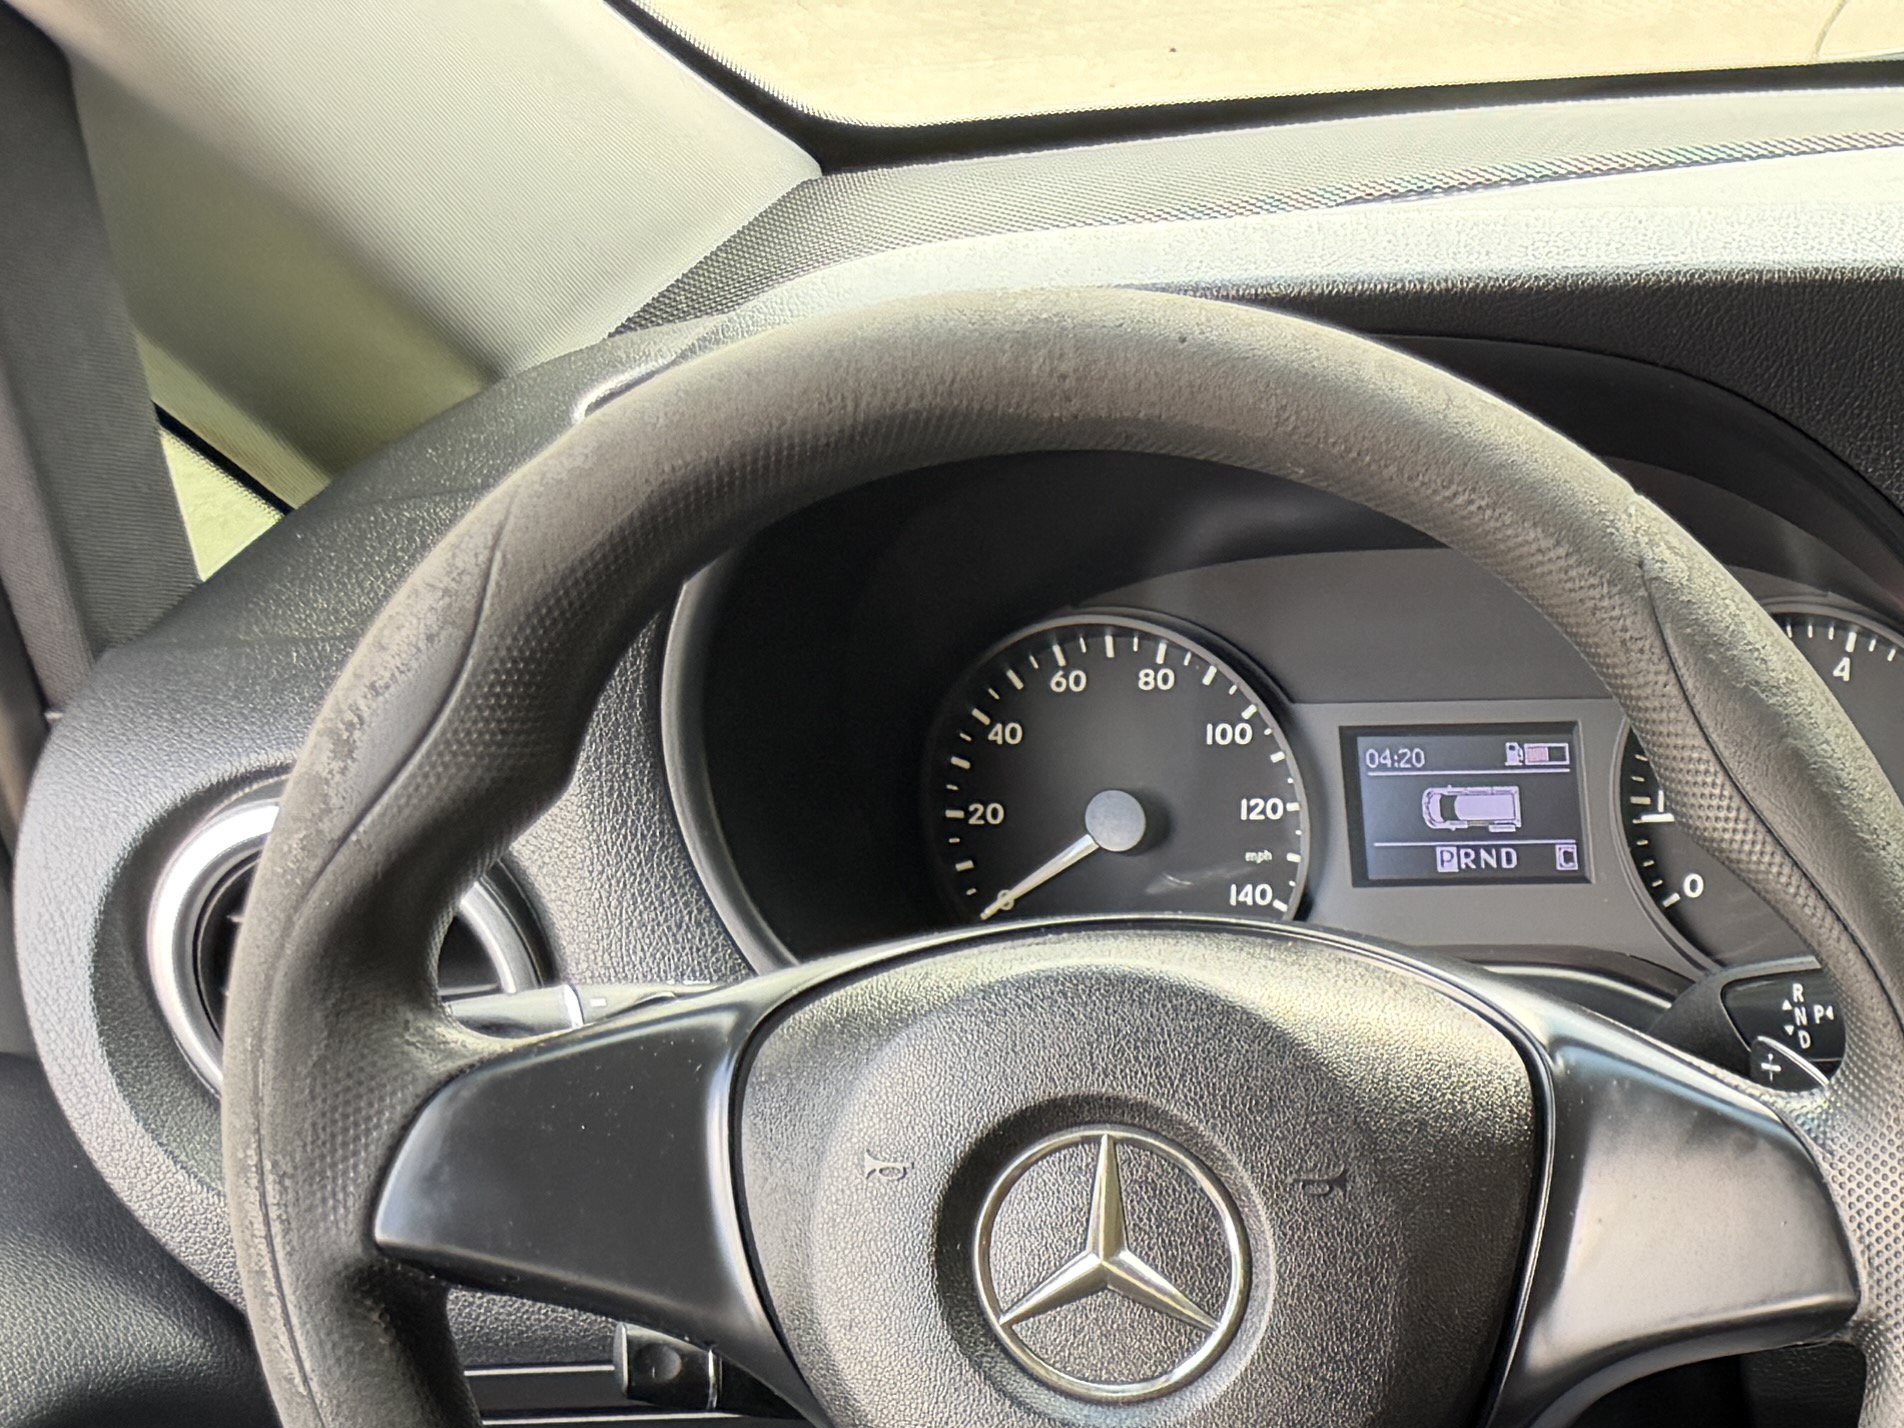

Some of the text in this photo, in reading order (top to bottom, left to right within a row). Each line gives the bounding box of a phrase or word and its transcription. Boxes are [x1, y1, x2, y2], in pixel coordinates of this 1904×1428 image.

[1137, 667, 1176, 691] 80
[1832, 656, 1851, 682] 4
[1049, 670, 1087, 693] 60
[987, 722, 1023, 745] 40
[1205, 722, 1253, 746] 100
[1365, 748, 1426, 769] 04:20
[967, 803, 1005, 825] 20
[1241, 798, 1284, 822] 120
[1245, 851, 1273, 863] mph
[1229, 883, 1273, 906] 140
[1683, 874, 1704, 898] 0
[1792, 983, 1804, 1003] R
[1794, 1004, 1824, 1026] N P
[1798, 1030, 1811, 1049] D
